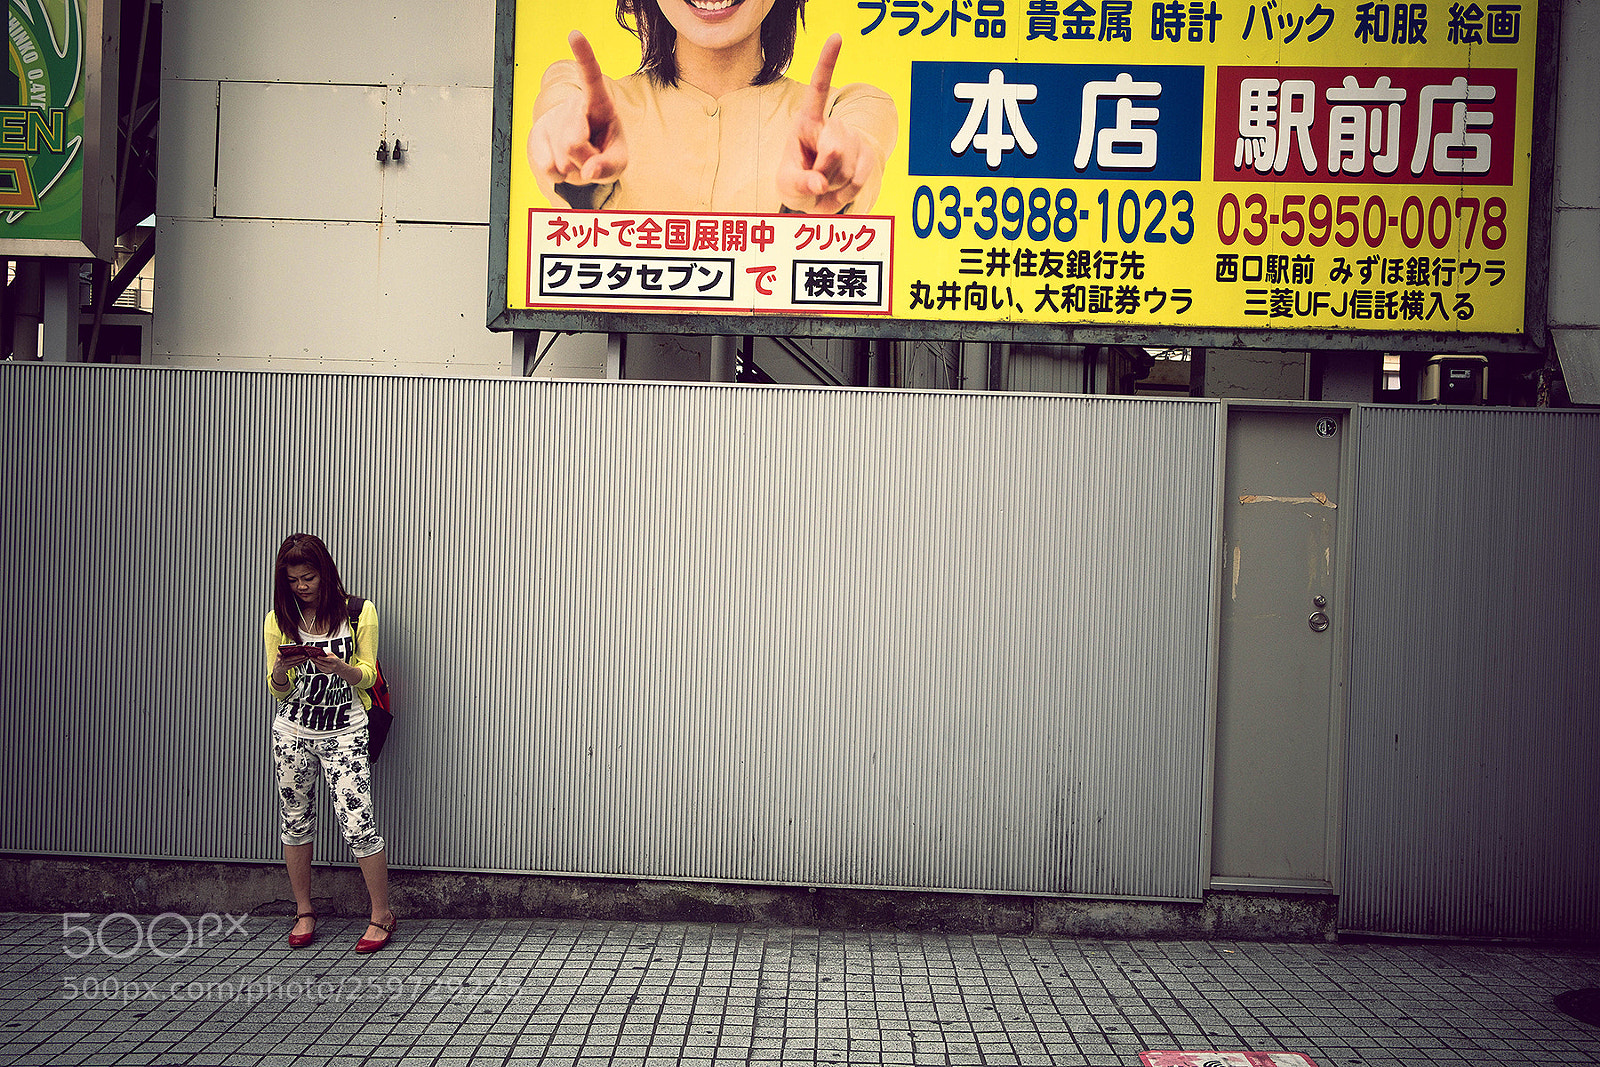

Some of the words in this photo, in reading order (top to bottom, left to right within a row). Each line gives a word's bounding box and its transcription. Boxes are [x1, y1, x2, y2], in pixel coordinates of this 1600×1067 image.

[9, 11, 39, 64] HINKO
[858, 0, 1005, 38] ブランド品
[1026, 0, 1132, 42] 貴金属
[1151, 0, 1223, 43] 時計
[1242, 0, 1335, 44] バック
[1354, 1, 1428, 45] 和服
[1447, 2, 1522, 45] 絵画
[1234, 75, 1497, 177] 駅前店
[912, 185, 1195, 245] 03-3988-1023
[1217, 192, 1508, 250] 03-5950-0078
[546, 216, 775, 252] ネットで全国展開中
[794, 223, 877, 253] クリック
[546, 261, 724, 293] クラタセブン
[746, 265, 778, 296] で
[804, 266, 868, 299] 検索
[958, 247, 1146, 280] 三井住友銀行先
[1215, 253, 1316, 285] 西口駅前
[1329, 254, 1507, 287] みずほ銀行ウラ
[910, 279, 1193, 315] 丸井向い、大和証券ウラ
[1244, 287, 1476, 322] 三菱UFJ信託横入る
[287, 699, 353, 732] TIME
